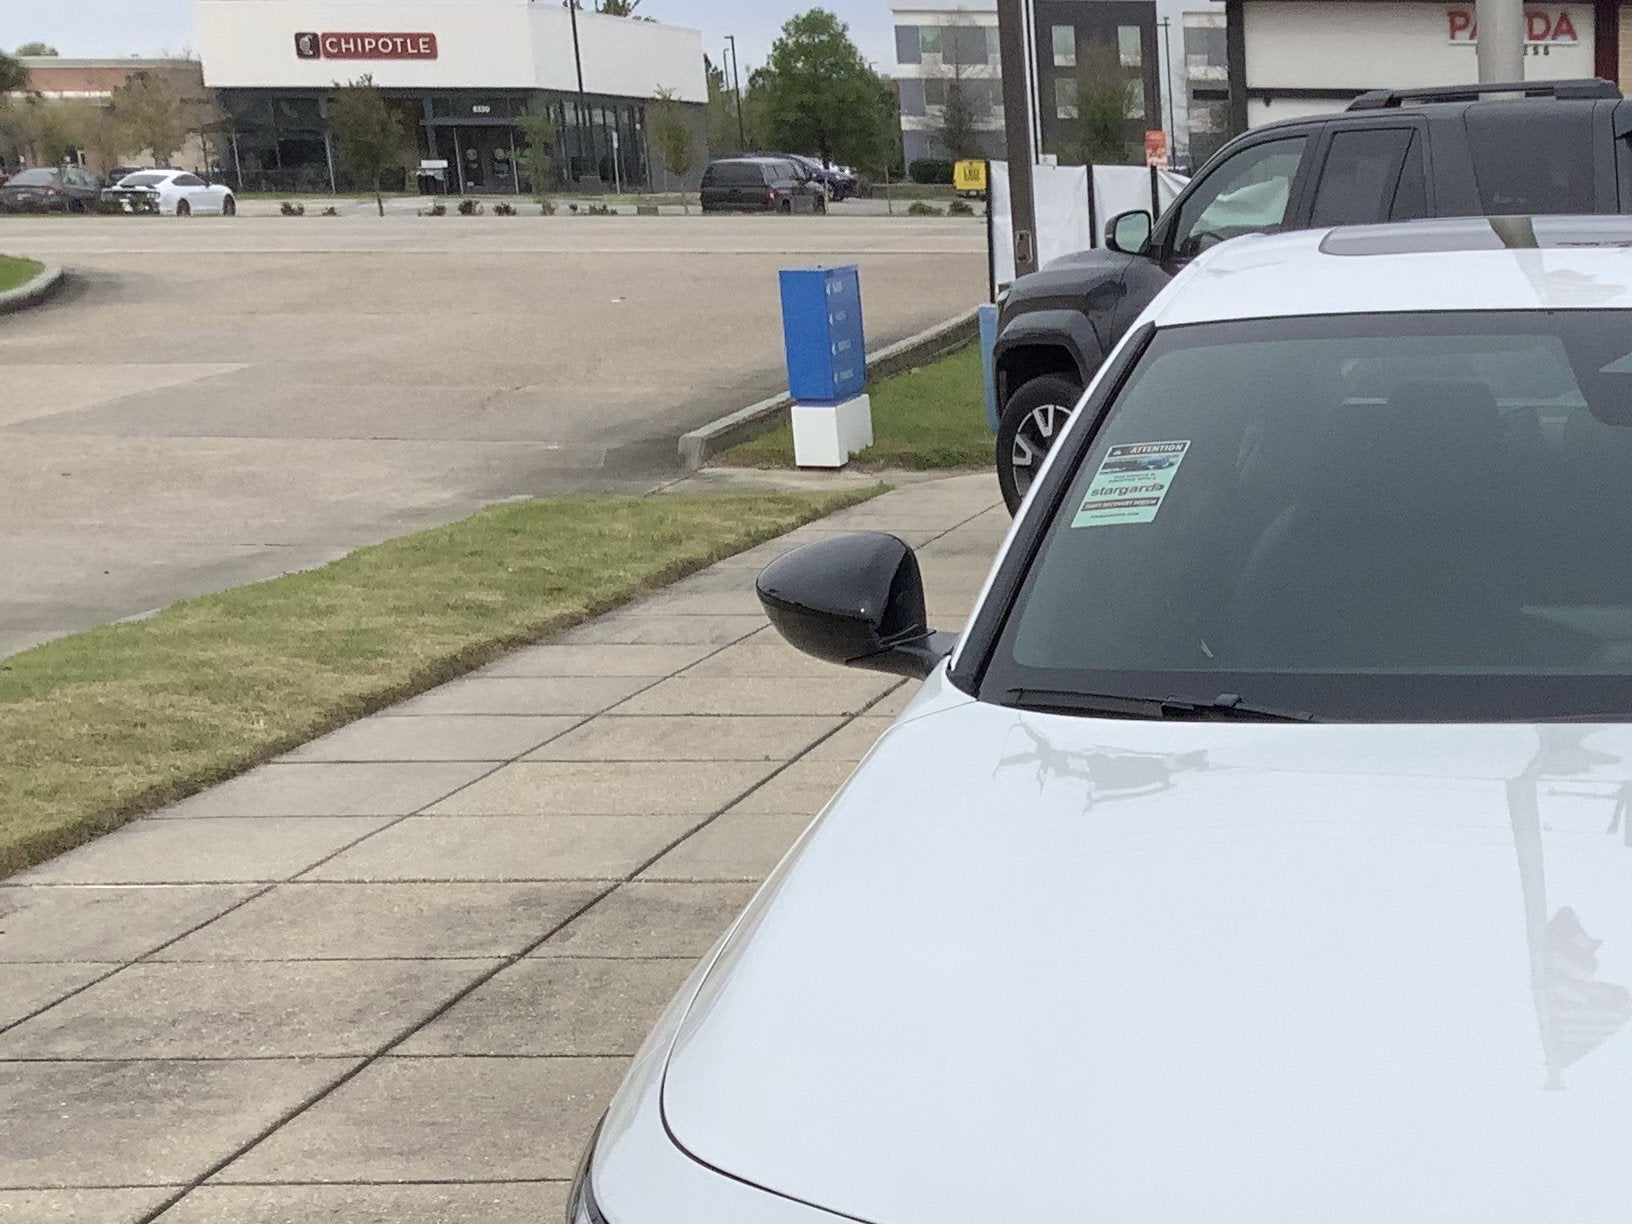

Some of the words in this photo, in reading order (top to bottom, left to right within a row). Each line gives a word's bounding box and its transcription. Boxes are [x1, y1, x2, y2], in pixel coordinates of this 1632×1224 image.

[1446, 10, 1578, 41] PDA
[325, 37, 431, 53] CHIPOTLE
[1129, 443, 1183, 454] ATTENTION
